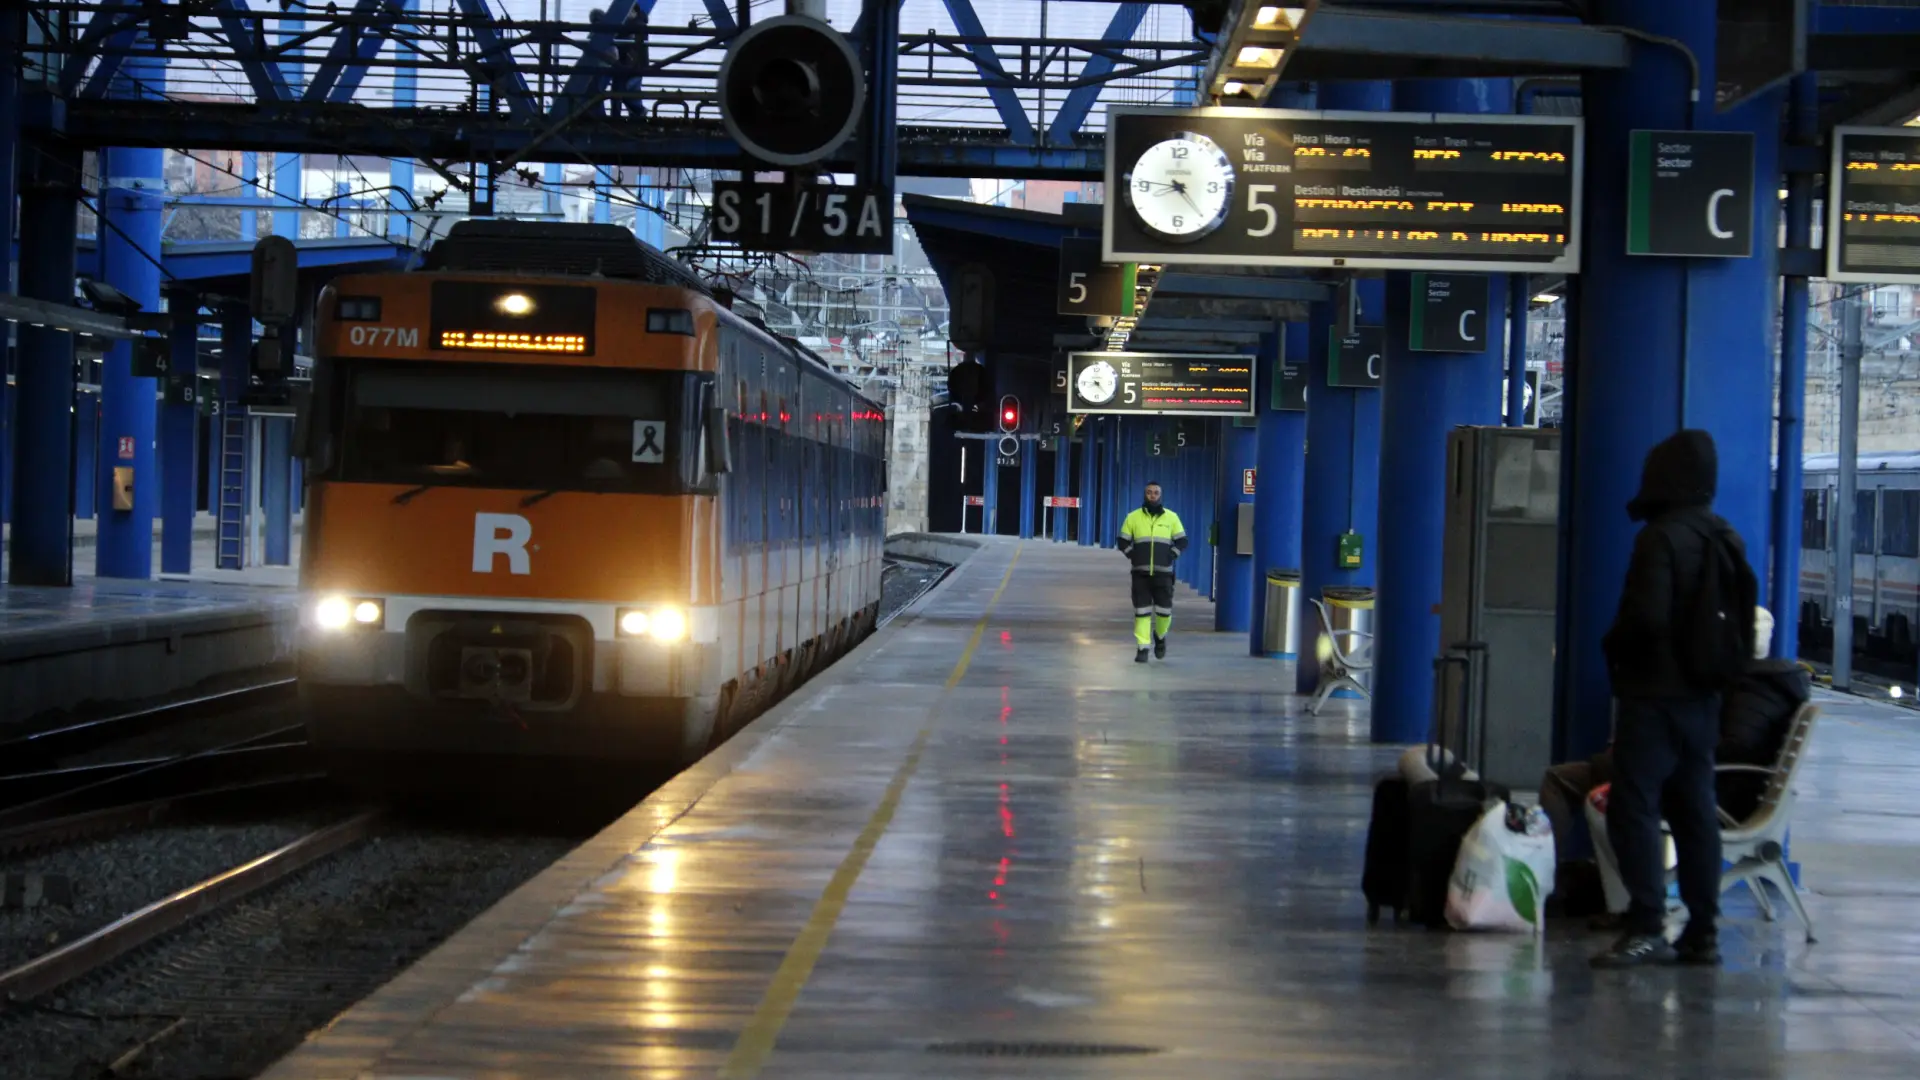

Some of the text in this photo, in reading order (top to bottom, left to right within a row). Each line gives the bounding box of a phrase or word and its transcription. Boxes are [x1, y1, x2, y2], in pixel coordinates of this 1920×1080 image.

[1294, 134, 1318, 144] Hora
[1325, 134, 1351, 145] Hora
[1444, 136, 1468, 147] Tren
[1171, 147, 1188, 159] 12
[1658, 142, 1692, 153] Sector
[1243, 163, 1291, 173] PLATFORM
[1657, 157, 1692, 168] Sector
[1139, 181, 1150, 192] 9
[1207, 182, 1218, 193] 3
[1295, 185, 1335, 196] Destino
[1342, 185, 1400, 197] Destinació
[1247, 184, 1277, 237] 5
[1707, 188, 1735, 239] C
[1172, 216, 1183, 228] 6
[1069, 272, 1087, 303] 5
[1428, 289, 1450, 297] Sector
[1459, 309, 1476, 341] C
[349, 325, 419, 347] 077M
[156, 355, 168, 372] 4
[1366, 354, 1381, 379] C
[1056, 370, 1067, 388] 5
[1124, 382, 1136, 404] 5
[211, 400, 220, 415] 3
[1053, 422, 1060, 434] 5
[1177, 432, 1186, 447] 5
[1153, 443, 1161, 456] 5
[472, 511, 532, 575] R
